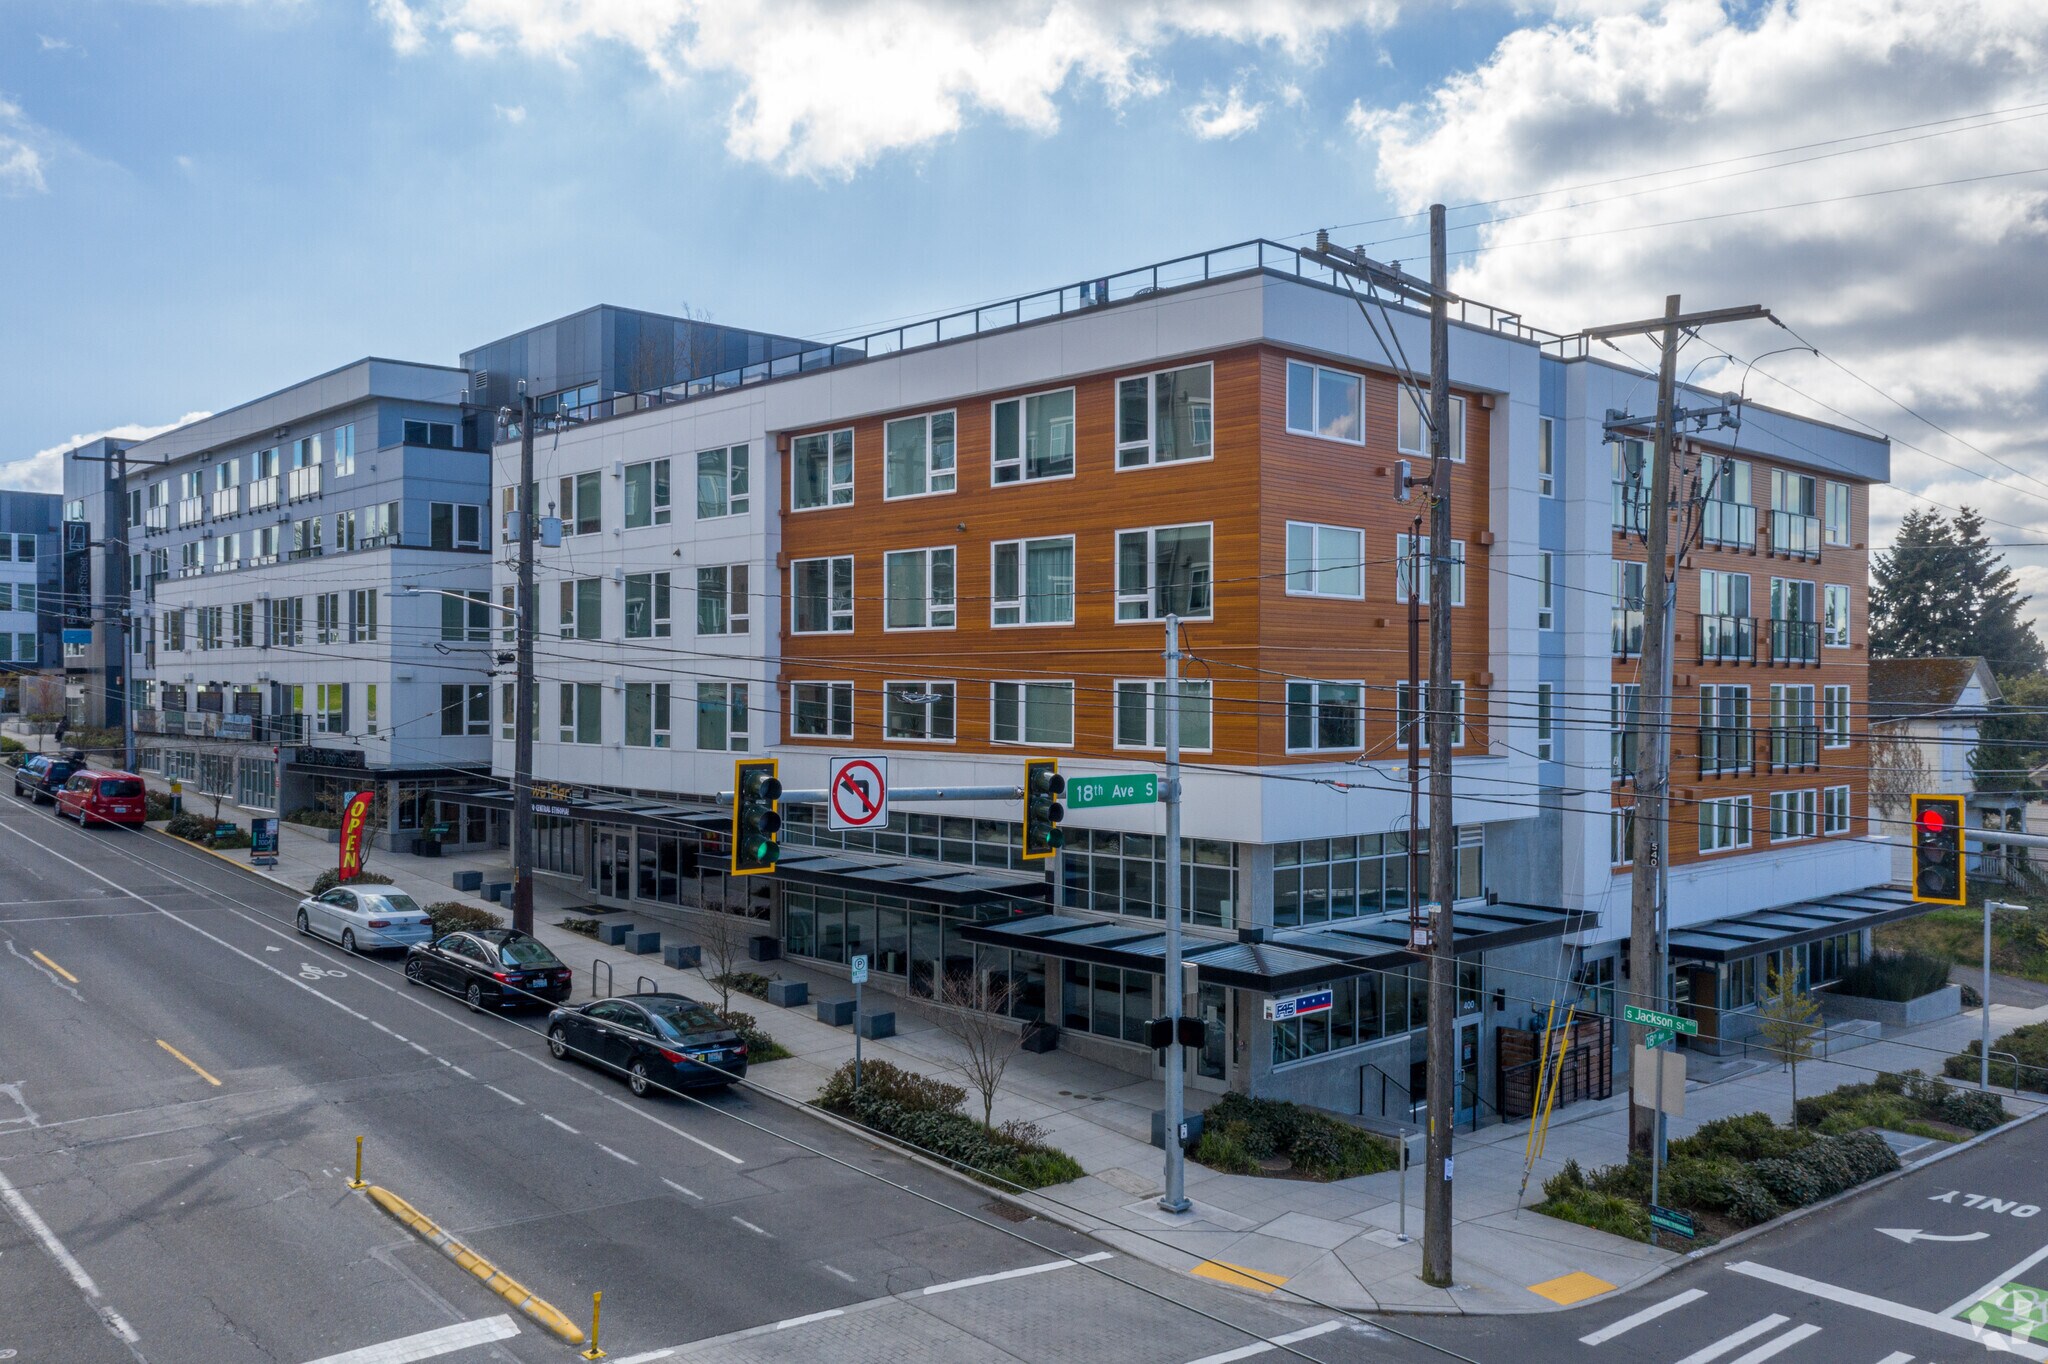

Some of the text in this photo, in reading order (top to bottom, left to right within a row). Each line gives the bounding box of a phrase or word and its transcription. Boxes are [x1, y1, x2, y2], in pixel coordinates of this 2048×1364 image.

[79, 557, 88, 584] Street
[1077, 782, 1154, 802] 18th Ave S
[536, 804, 552, 813] CENTRAL
[343, 801, 365, 868] OPEN
[1650, 842, 1658, 866] 540
[1276, 1001, 1296, 1019] F45
[1463, 1000, 1475, 1009] 400
[1626, 1010, 1632, 1019] S
[1635, 1009, 1673, 1028] Jackson
[1676, 1021, 1685, 1031] St
[1928, 1190, 2041, 1218] ONLY
